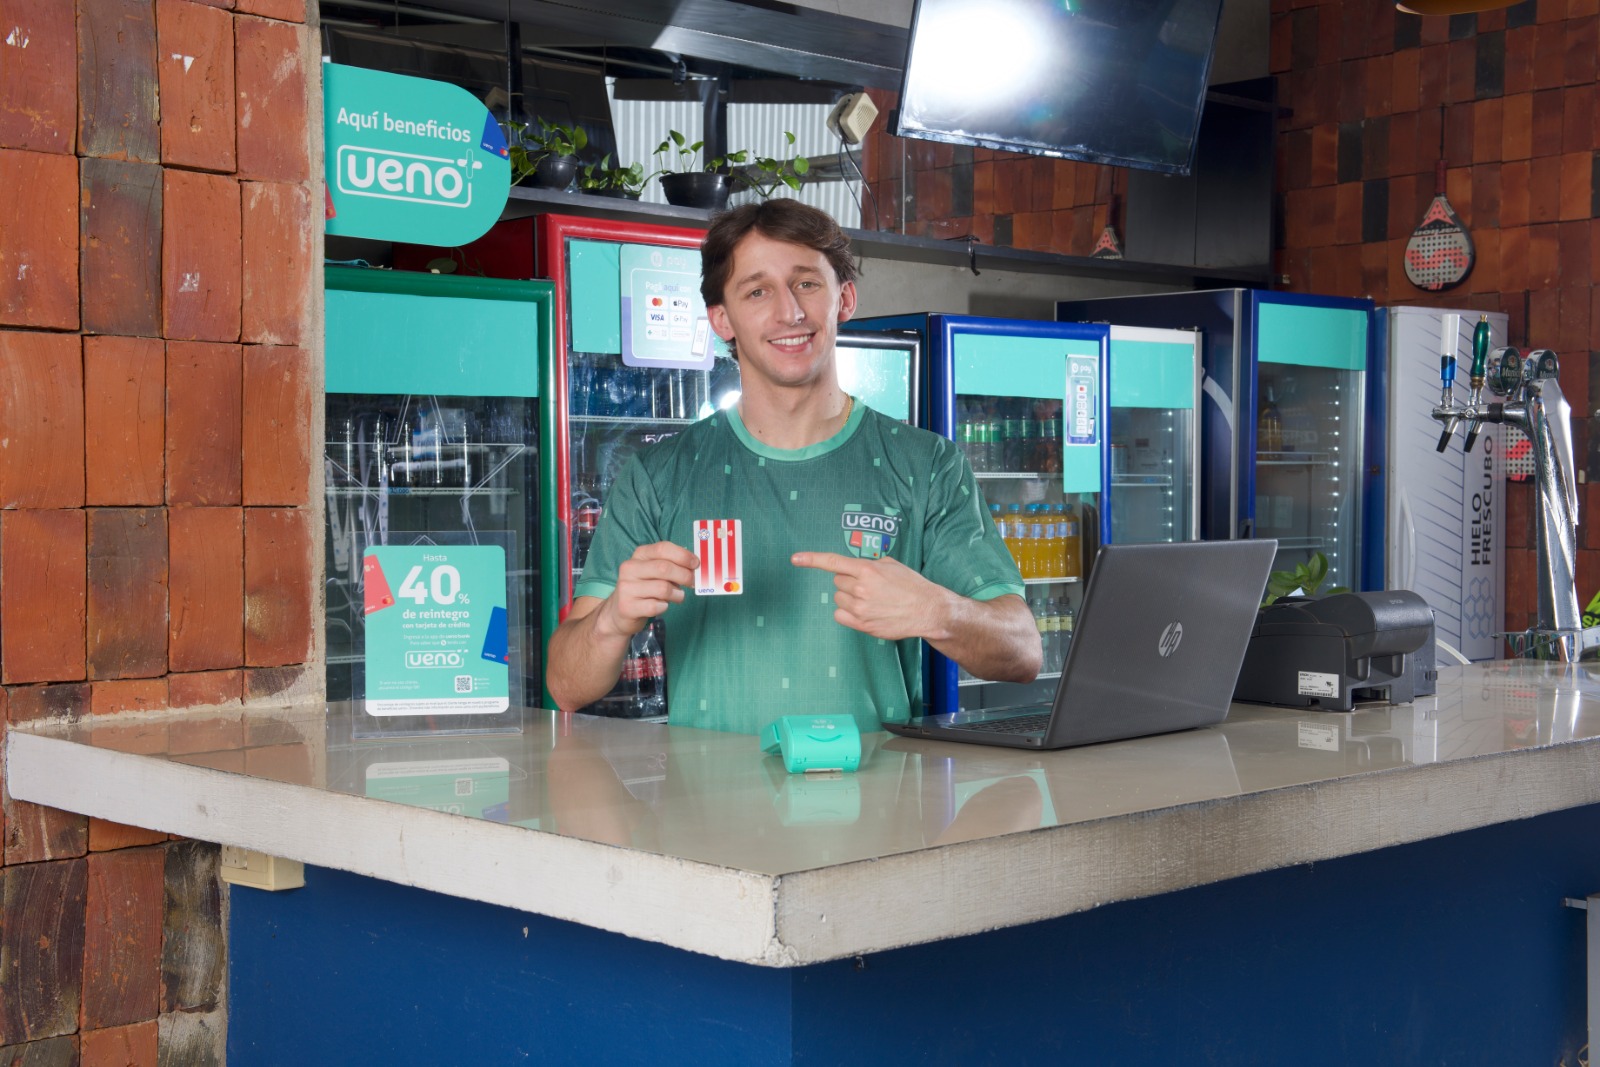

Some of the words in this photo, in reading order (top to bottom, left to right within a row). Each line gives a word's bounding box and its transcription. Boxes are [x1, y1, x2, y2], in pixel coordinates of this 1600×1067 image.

[337, 107, 379, 132] Aquí
[383, 112, 471, 143] beneficios
[650, 313, 665, 321] VISA
[1482, 435, 1493, 566] FRESCUBO
[846, 514, 895, 532] ueno
[1471, 493, 1482, 565] HIELO
[863, 535, 880, 549] TC
[423, 553, 447, 562] Hasta
[402, 609, 416, 619] de
[419, 609, 469, 622] reintegro
[415, 621, 437, 630] tarjeta
[438, 621, 447, 629] de
[448, 620, 470, 629] crédito
[408, 653, 460, 665] ueno
